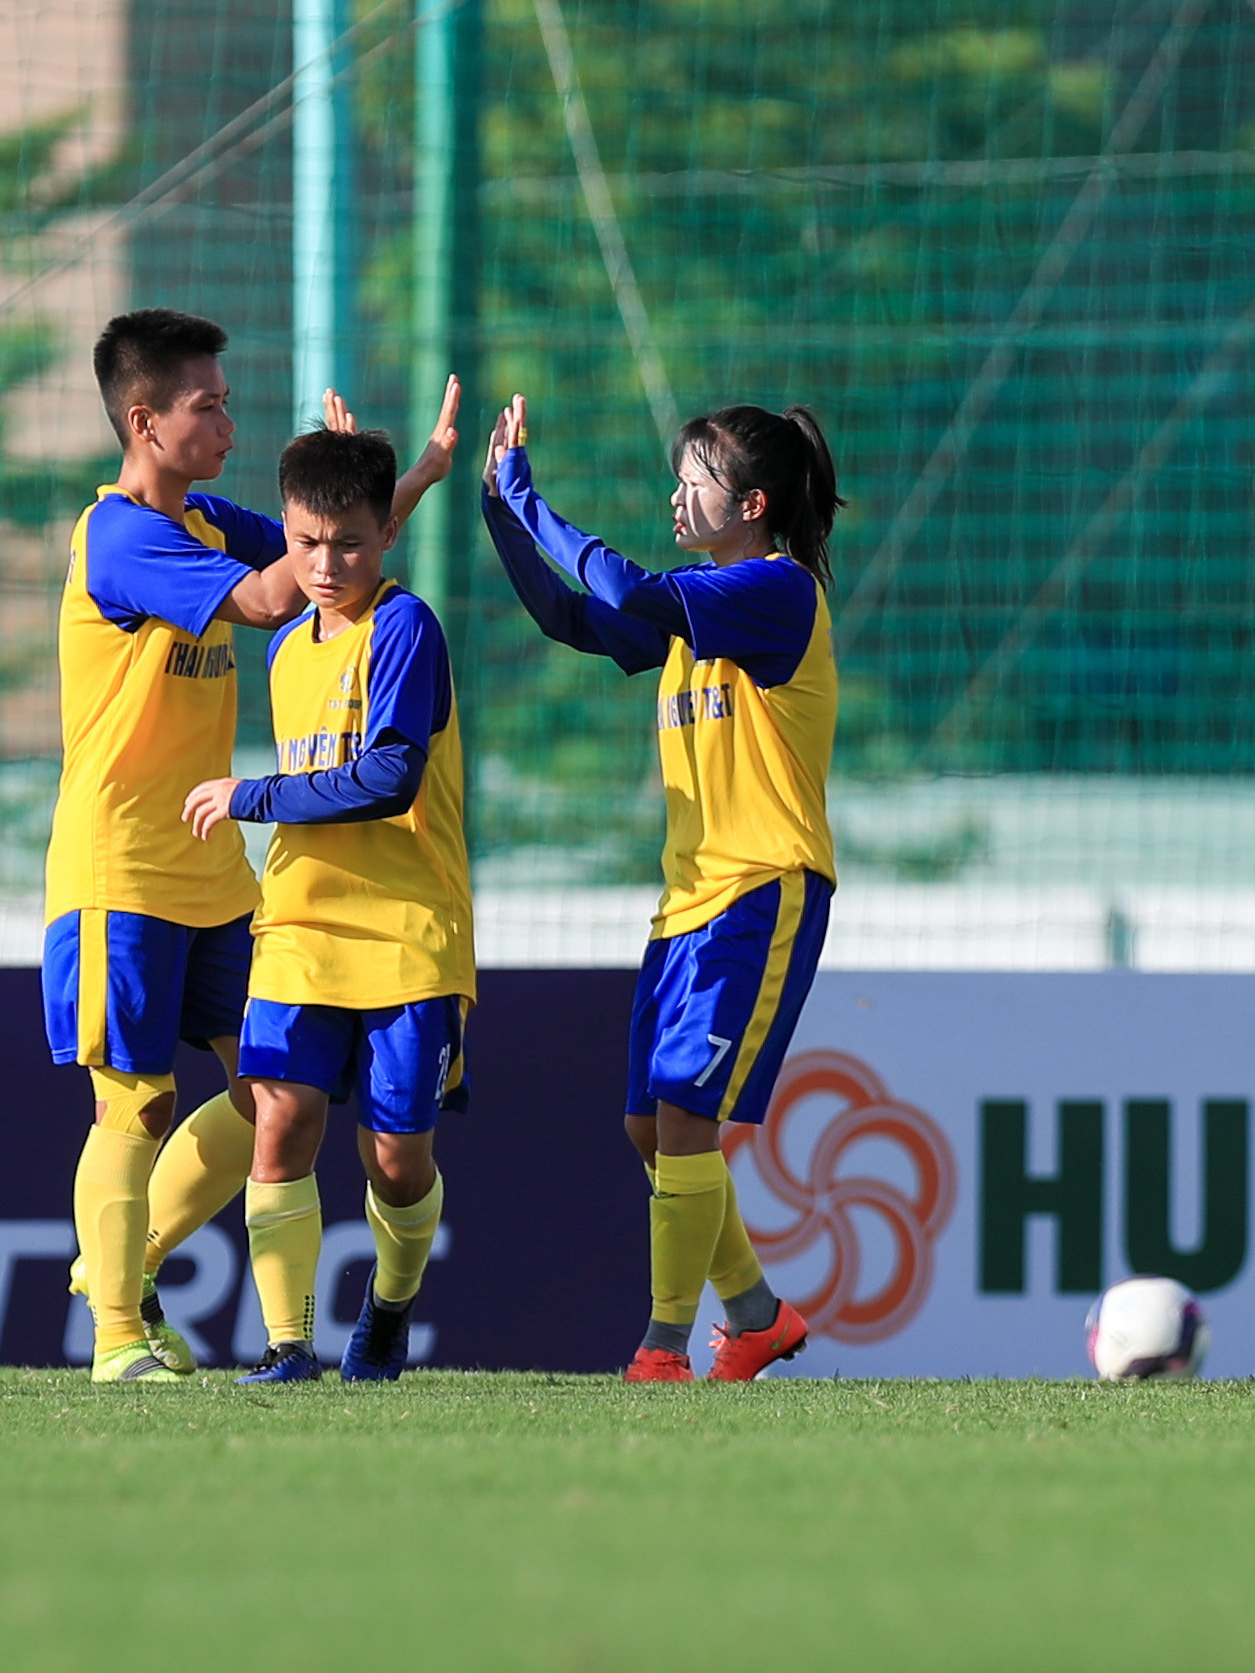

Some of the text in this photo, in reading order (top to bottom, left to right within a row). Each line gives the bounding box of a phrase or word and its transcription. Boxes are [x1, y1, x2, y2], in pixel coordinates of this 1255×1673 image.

[702, 683, 732, 720] T&T
[693, 1033, 733, 1088] 7
[978, 1096, 1250, 1297] HU
